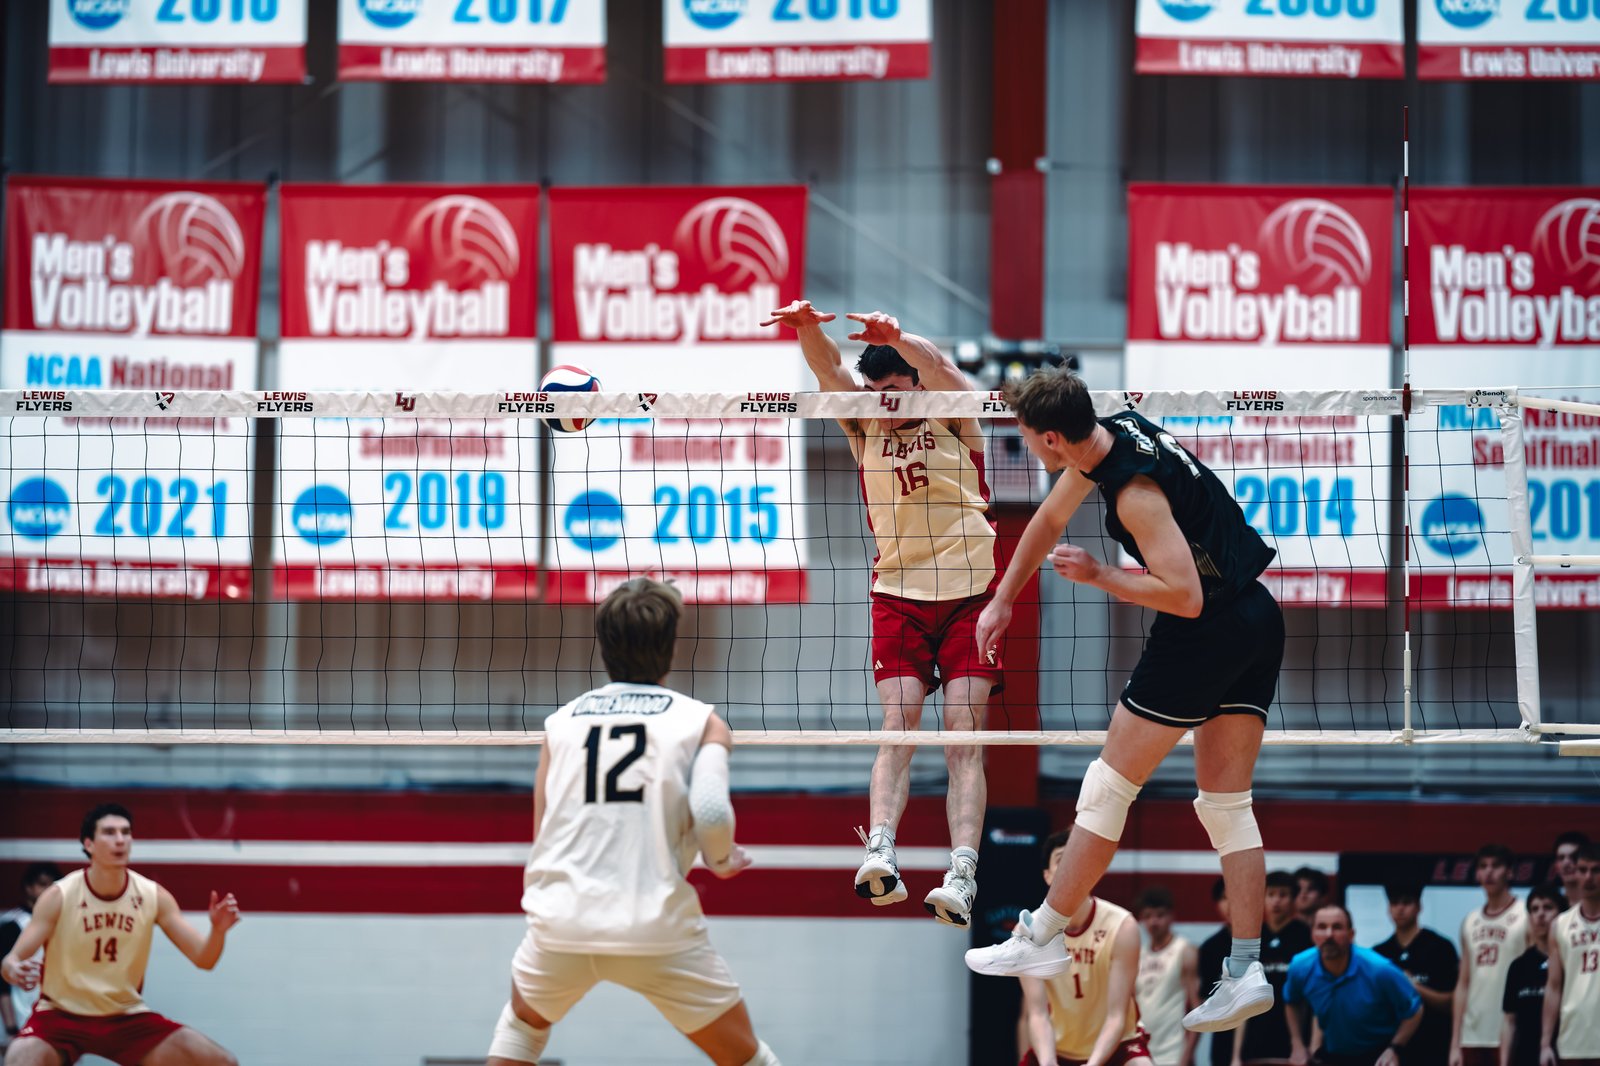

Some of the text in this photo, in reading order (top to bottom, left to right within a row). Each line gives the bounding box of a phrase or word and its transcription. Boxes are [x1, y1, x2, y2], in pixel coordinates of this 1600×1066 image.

[1460, 48, 1525, 77] Lewis
[32, 233, 133, 281] Men's
[305, 240, 409, 286] Men's
[574, 243, 679, 289] Men's
[1155, 243, 1260, 287] Men's
[1430, 244, 1534, 290] Men's
[31, 275, 233, 339] Volleyball
[305, 281, 509, 343] Volleyball
[574, 284, 779, 344] Volleyball
[1155, 285, 1361, 346] Volleyball
[27, 353, 234, 390] NCAA National
[16, 401, 73, 412] FLYERS
[22, 391, 65, 400] LEWIS
[257, 401, 314, 412] FLYERS
[264, 391, 307, 401] LEWIS
[498, 402, 555, 413] FLYERS
[505, 392, 548, 402] LEWIS
[740, 402, 797, 413] FLYERS
[747, 392, 791, 402] LEWIS
[1227, 401, 1284, 411] FLYERS
[1233, 390, 1277, 400] LEWIS
[882, 431, 936, 459] LEWIS
[894, 461, 930, 496] 16
[94, 475, 228, 541] 2021
[384, 471, 506, 530] 2019
[653, 485, 779, 544] 2015
[1236, 476, 1357, 537] 2014
[583, 723, 647, 803] 12
[83, 912, 135, 933] LEWIS
[92, 937, 118, 962] 14
[1581, 949, 1600, 975] 13
[1073, 973, 1084, 999] 1
